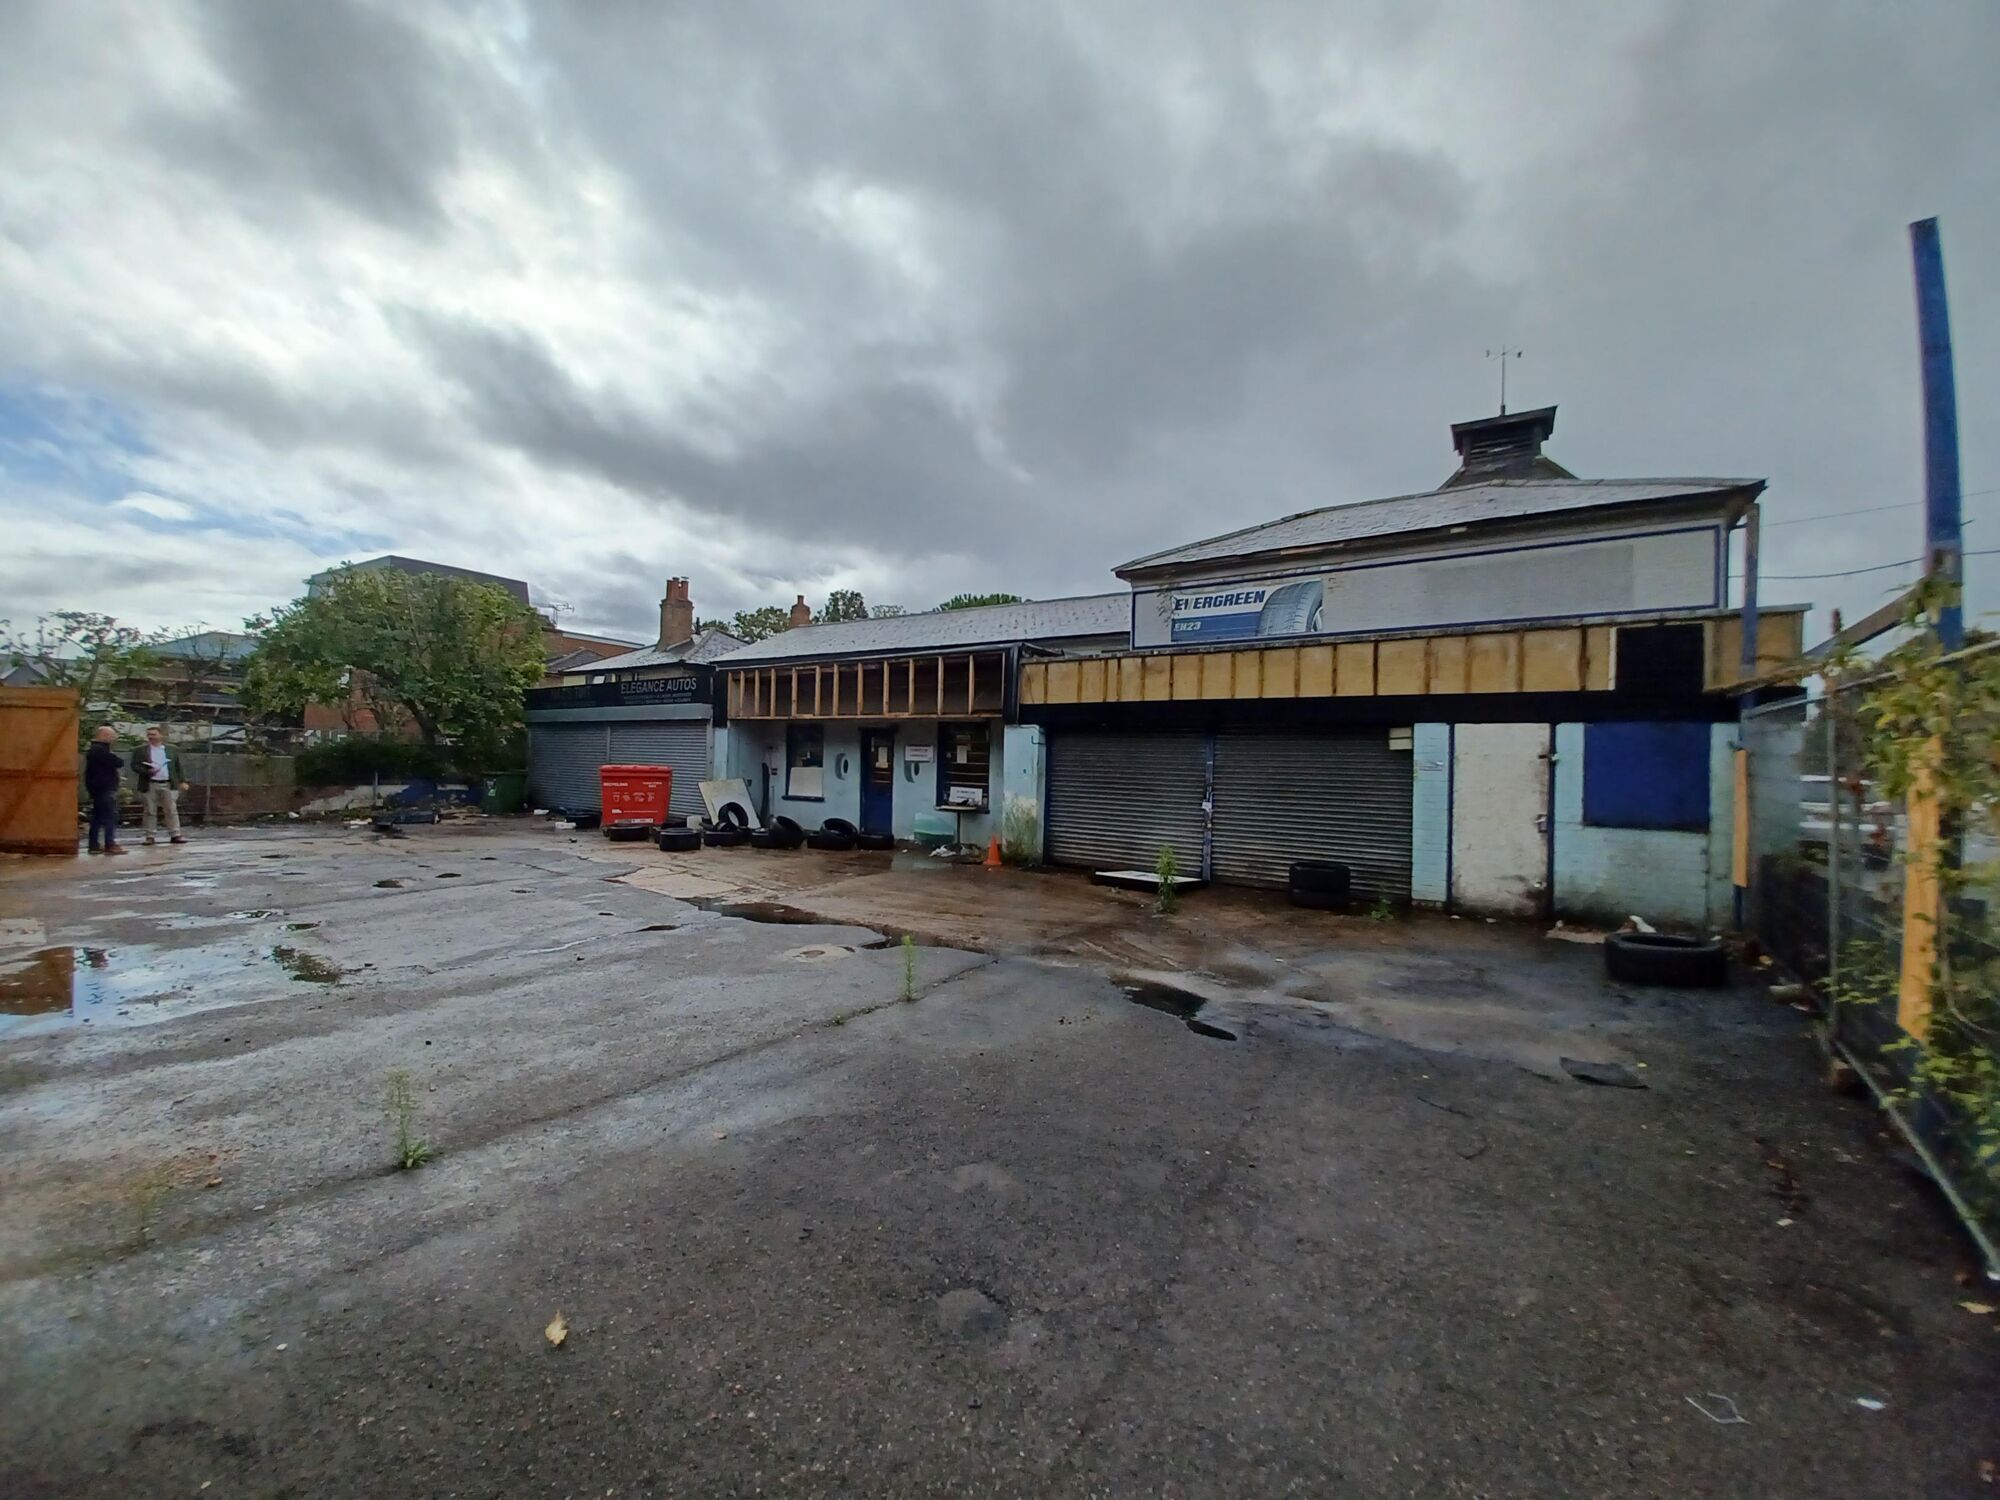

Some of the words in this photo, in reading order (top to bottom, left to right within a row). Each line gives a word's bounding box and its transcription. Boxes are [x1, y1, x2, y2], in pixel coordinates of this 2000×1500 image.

[1174, 590, 1266, 611] EVERGREEN
[1173, 621, 1202, 632] EH23
[621, 680, 665, 694] ELEGANCE
[666, 677, 697, 691] AUTOS
